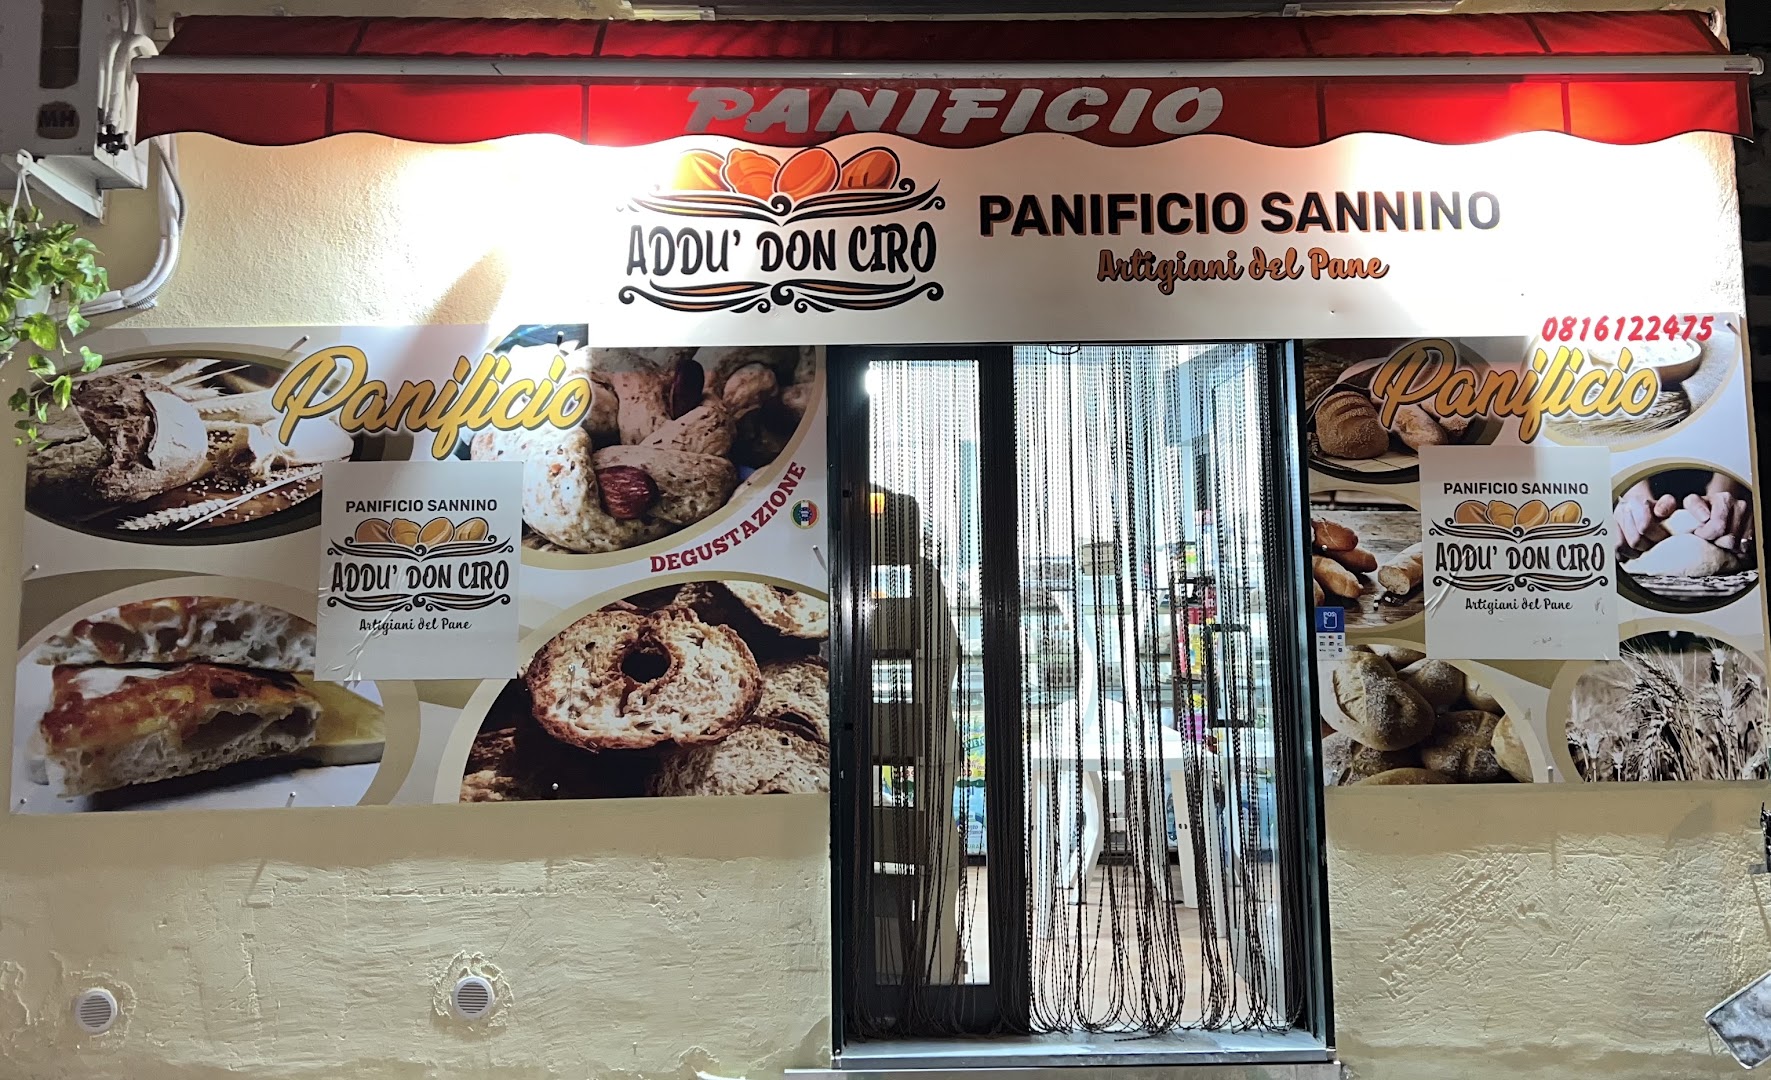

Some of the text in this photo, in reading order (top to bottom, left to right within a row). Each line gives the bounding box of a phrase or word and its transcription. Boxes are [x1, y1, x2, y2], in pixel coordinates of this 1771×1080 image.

[684, 86, 1224, 135] PANIFICIO
[979, 191, 1500, 238] PANIFICIO SANNINO
[626, 220, 938, 276] ADDU' DON CIRO
[1097, 246, 1390, 296] Artigiani del Pane
[1541, 315, 1715, 342] 0816122475
[271, 345, 593, 461] Panificio
[1372, 338, 1660, 444] Panificio
[345, 498, 498, 513] PANIFICIO SANNINO
[1443, 482, 1589, 495] PANIFICIO SANNINO
[650, 461, 806, 573] DEGUSTAZIONE
[331, 559, 510, 593] ADDU' DON CIRO
[1435, 542, 1606, 572] ADDU' DON CIRO
[1465, 596, 1574, 615] Artigiani del Pane
[359, 616, 473, 636] Artigiani del Pane
